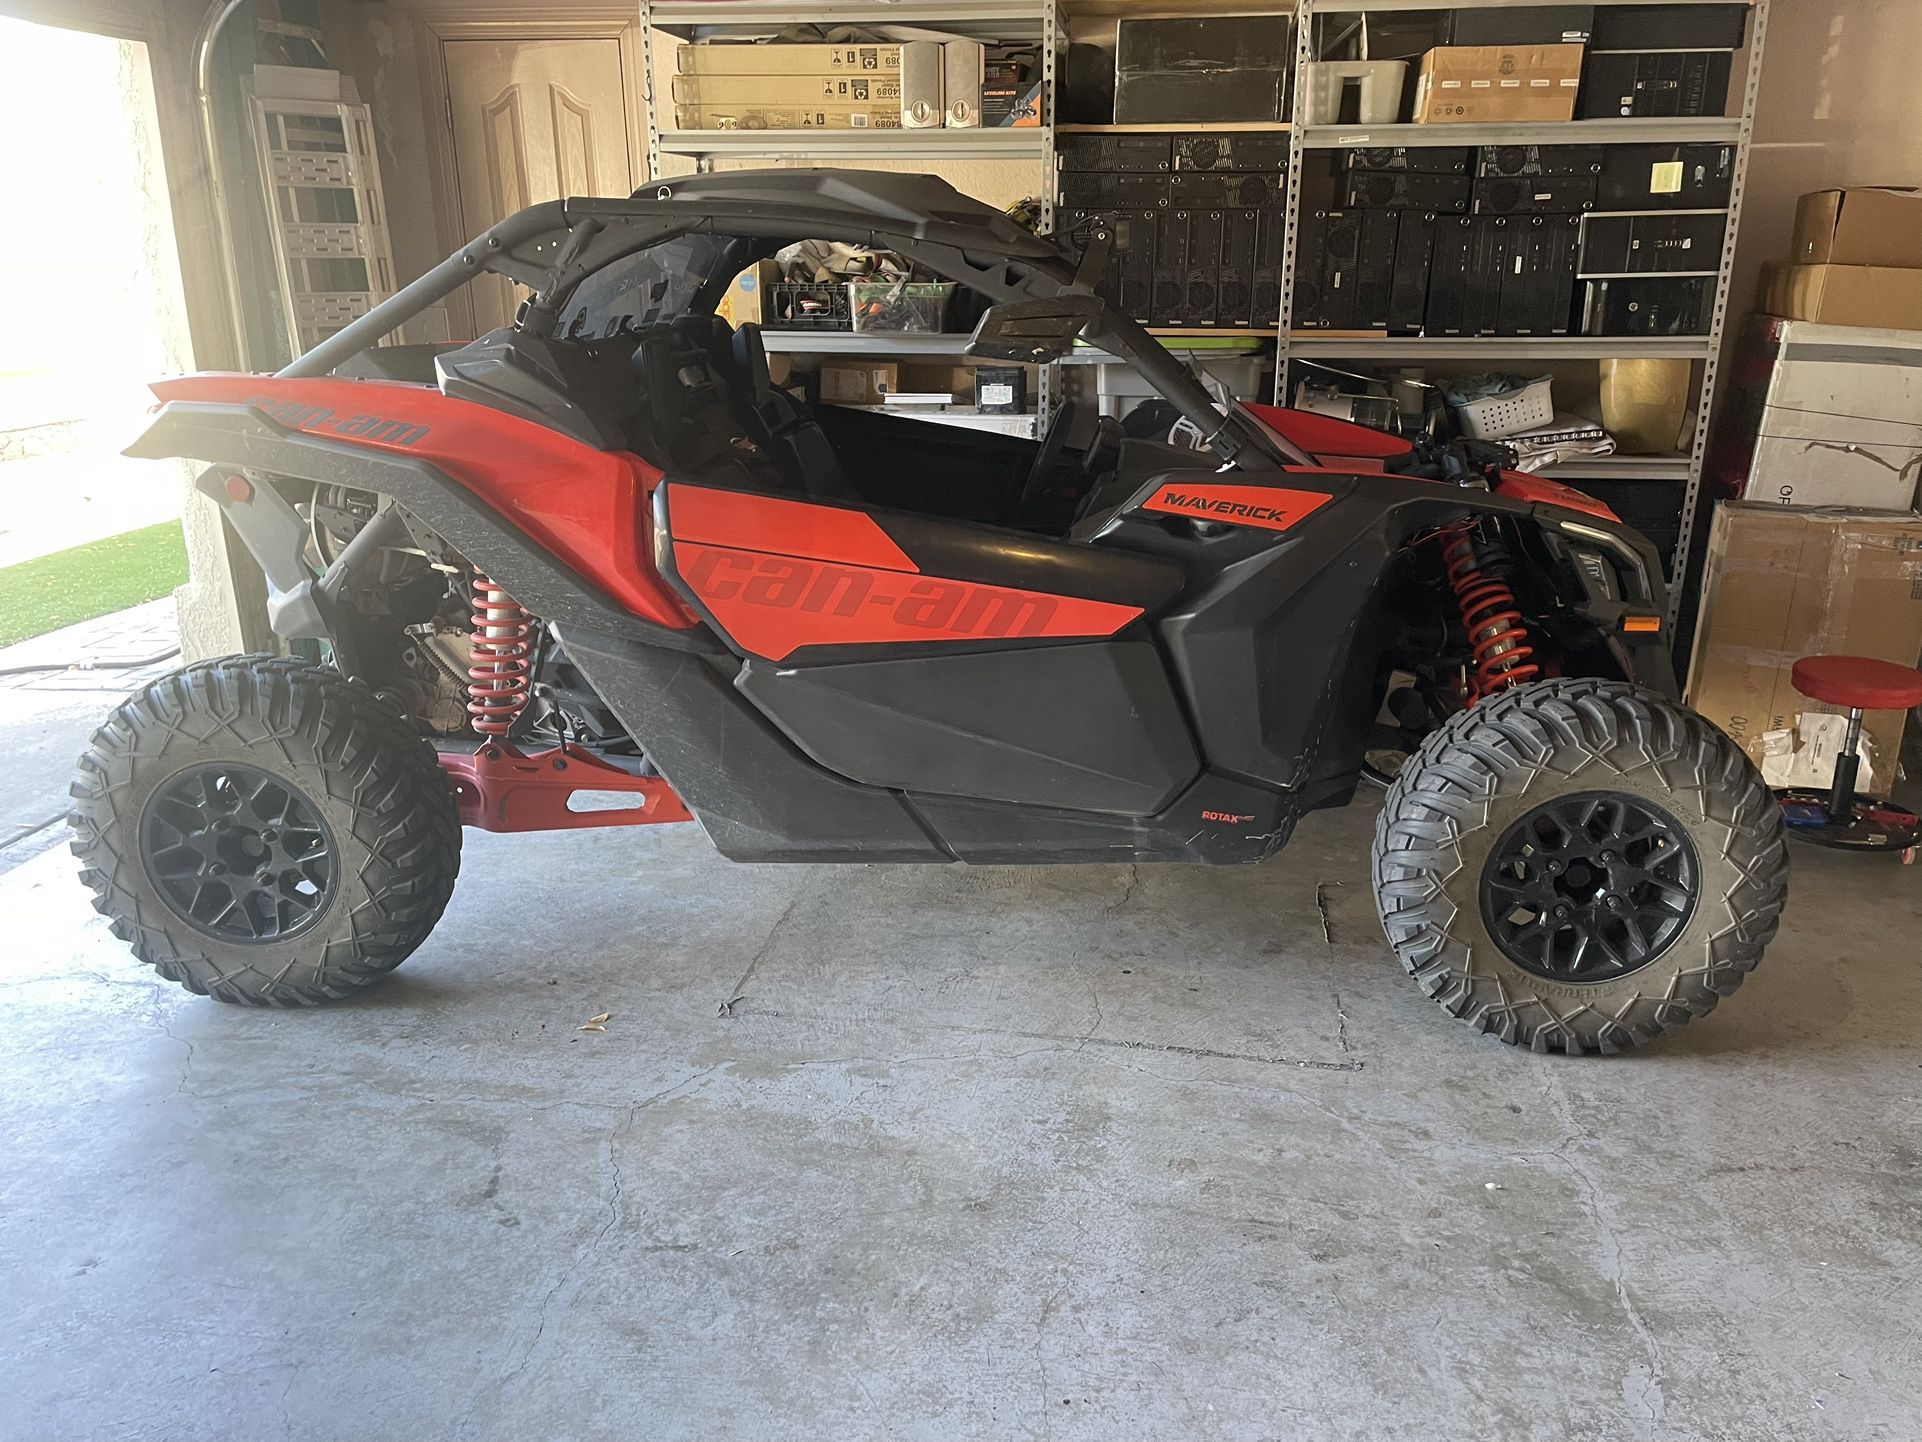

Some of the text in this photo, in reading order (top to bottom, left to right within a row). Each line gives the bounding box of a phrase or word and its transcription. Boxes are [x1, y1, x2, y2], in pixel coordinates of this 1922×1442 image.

[1163, 492, 1288, 522] MAVERICK
[686, 549, 1058, 637] can-am
[1201, 810, 1239, 824] ROTAX
